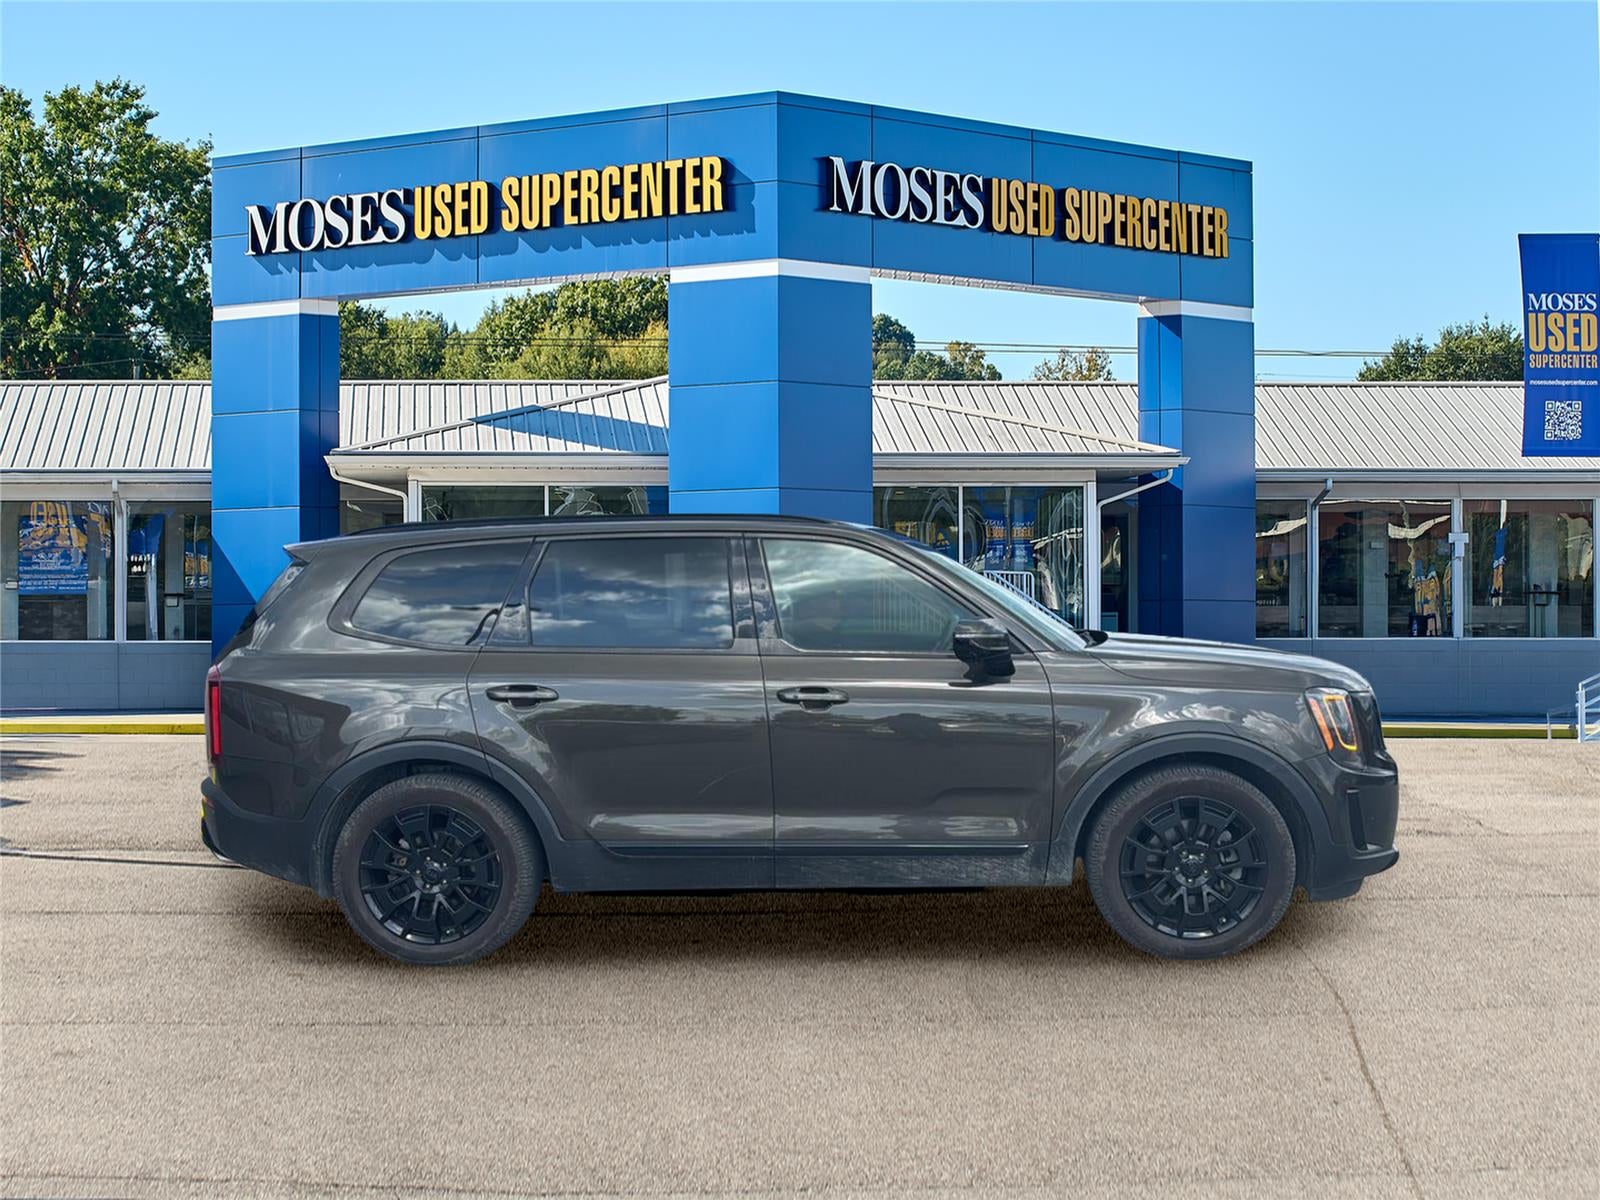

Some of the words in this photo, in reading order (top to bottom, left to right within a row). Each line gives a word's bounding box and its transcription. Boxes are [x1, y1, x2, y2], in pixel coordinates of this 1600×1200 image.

[245, 189, 407, 256] MOSES
[413, 181, 489, 240] USED
[501, 156, 724, 232] SUPERCENTER
[829, 156, 984, 229] MOSES
[991, 178, 1055, 237] USED
[1064, 187, 1229, 258] SUPERCENTER
[1527, 293, 1597, 311] MOSES
[1528, 313, 1598, 352] USED
[1529, 354, 1598, 369] SUPERCENTER
